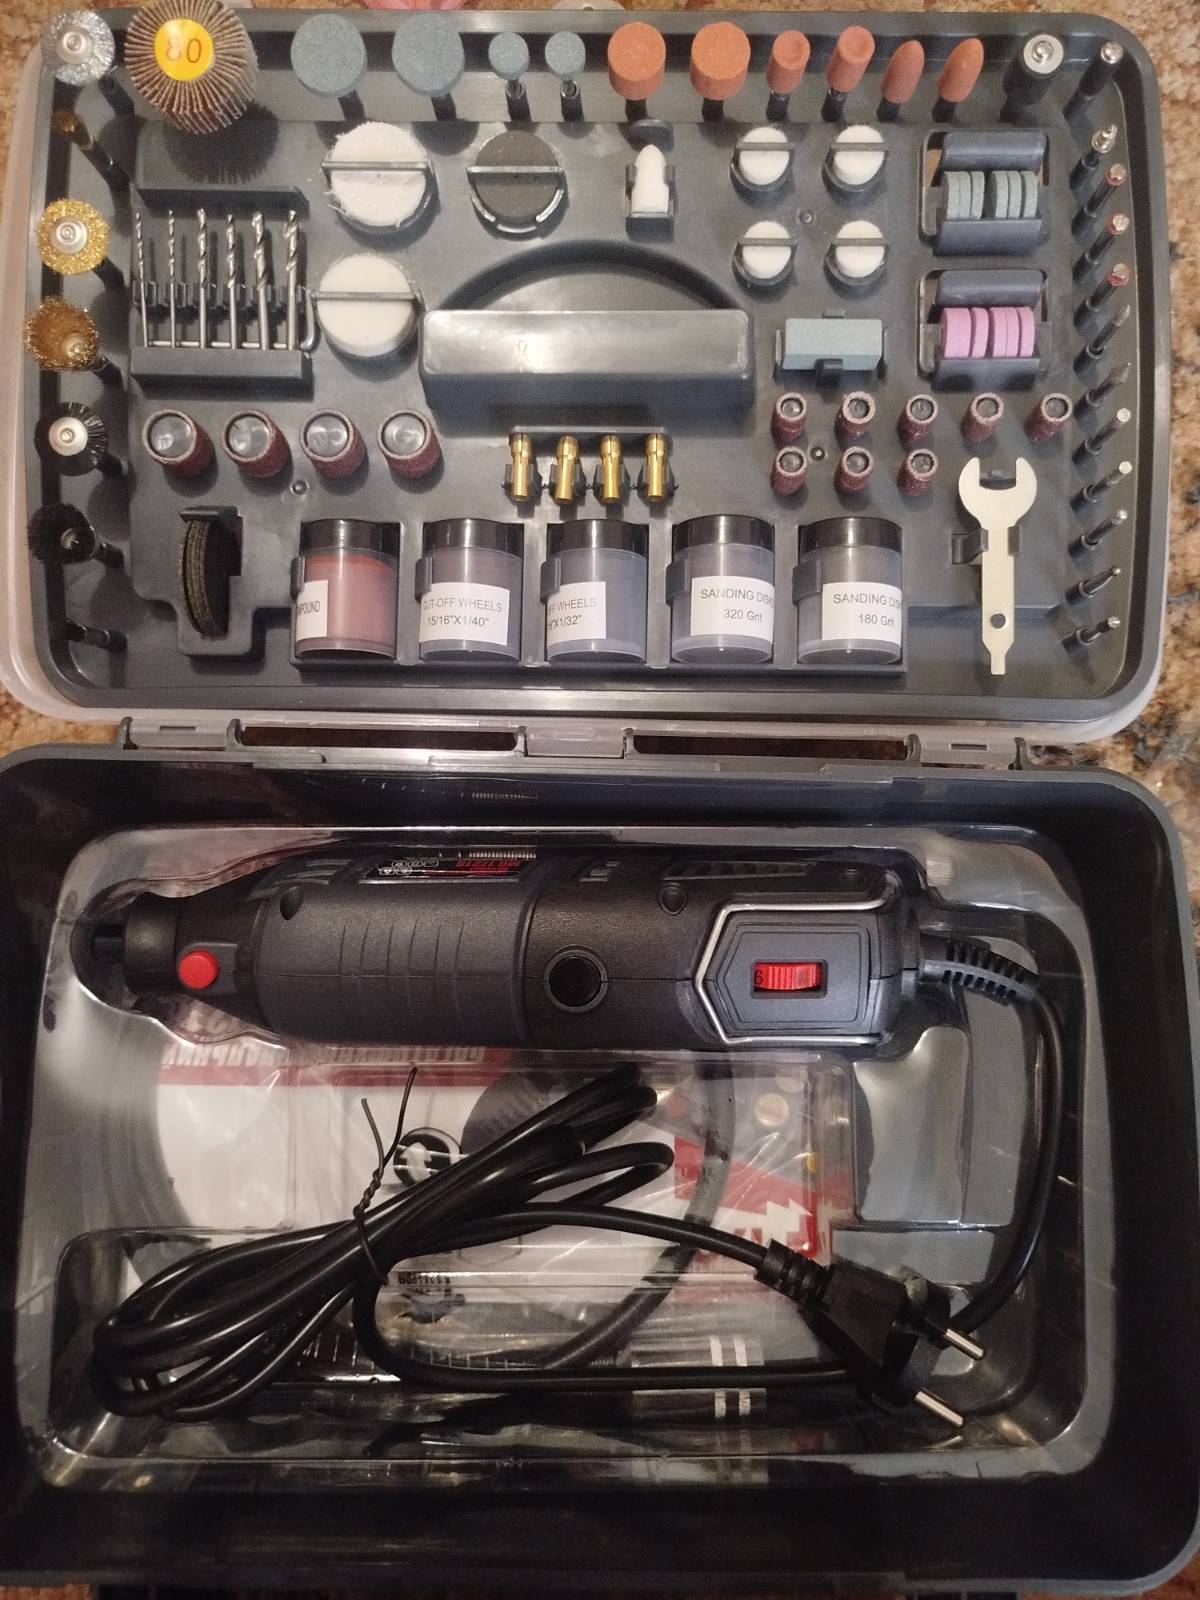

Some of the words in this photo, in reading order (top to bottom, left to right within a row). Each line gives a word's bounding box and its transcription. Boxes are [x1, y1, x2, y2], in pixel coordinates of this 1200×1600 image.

[700, 588, 755, 601] SANDING
[833, 593, 887, 606] SANDING
[458, 597, 503, 613] WHEELS
[557, 598, 597, 612] WHEELS
[723, 608, 744, 620] 320
[746, 610, 763, 623] Grit
[858, 614, 878, 625] 180
[880, 615, 895, 626] Grit
